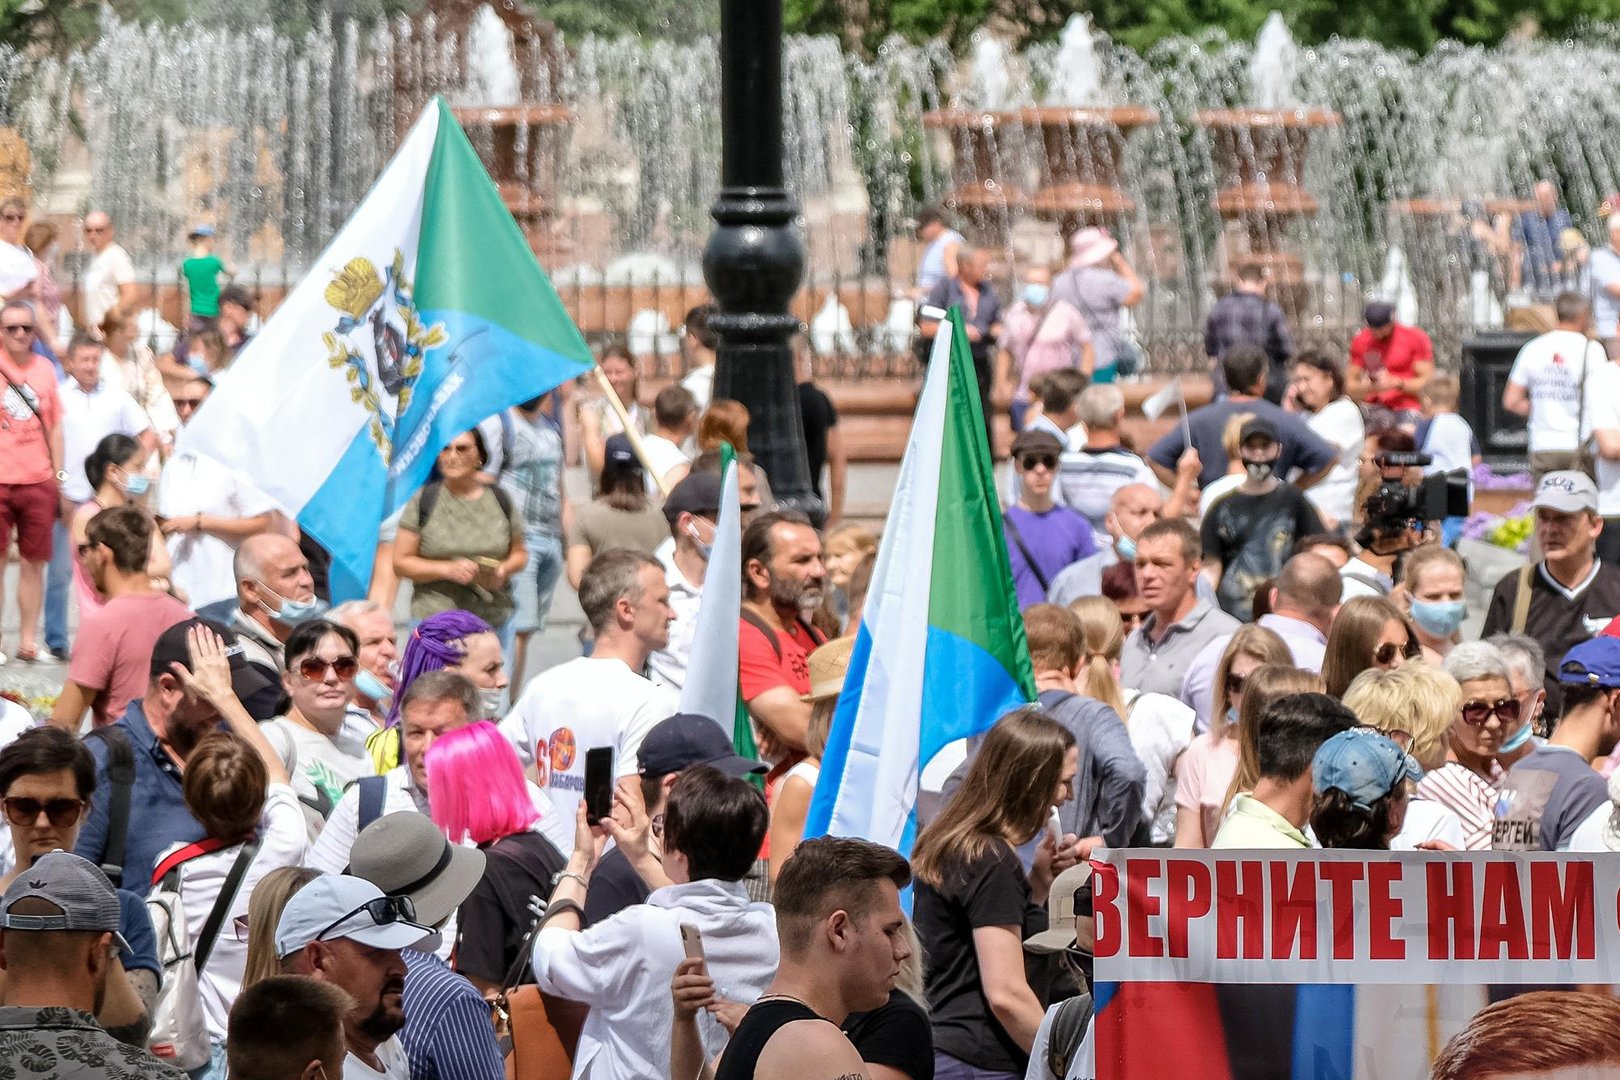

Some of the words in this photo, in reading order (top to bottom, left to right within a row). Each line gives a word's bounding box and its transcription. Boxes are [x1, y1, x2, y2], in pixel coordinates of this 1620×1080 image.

[1492, 815, 1534, 844] ЕРГЕЙ
[1093, 859, 1405, 960] ВЕРНИТЕ
[1425, 859, 1596, 960] НАМ
